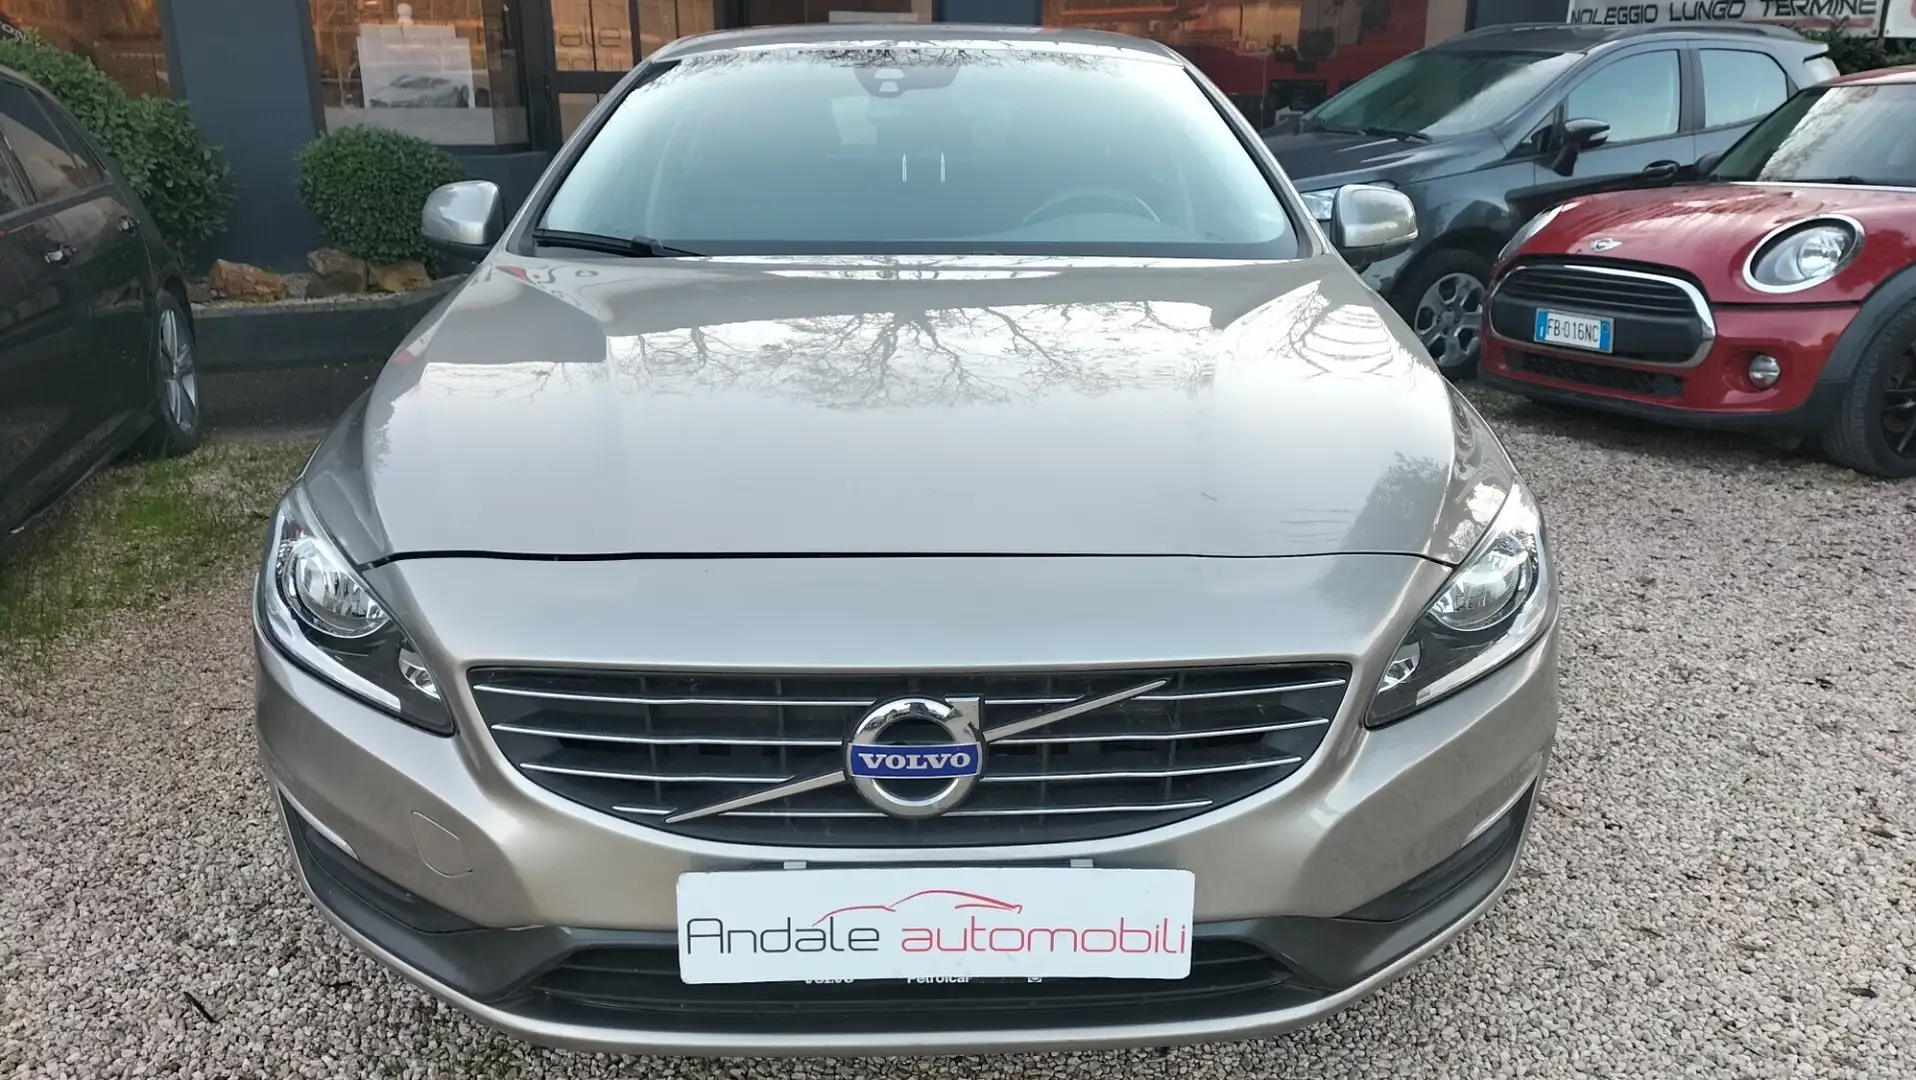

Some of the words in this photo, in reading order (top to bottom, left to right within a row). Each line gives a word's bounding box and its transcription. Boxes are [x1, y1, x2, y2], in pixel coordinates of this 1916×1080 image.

[1570, 4, 1658, 25] NOLEGGIO
[1669, 0, 1746, 22] LUNGO
[1761, 0, 1878, 17] TERMINE
[858, 752, 971, 770] VOLVO
[687, 916, 880, 954] Andale
[901, 916, 1185, 954] automobili
